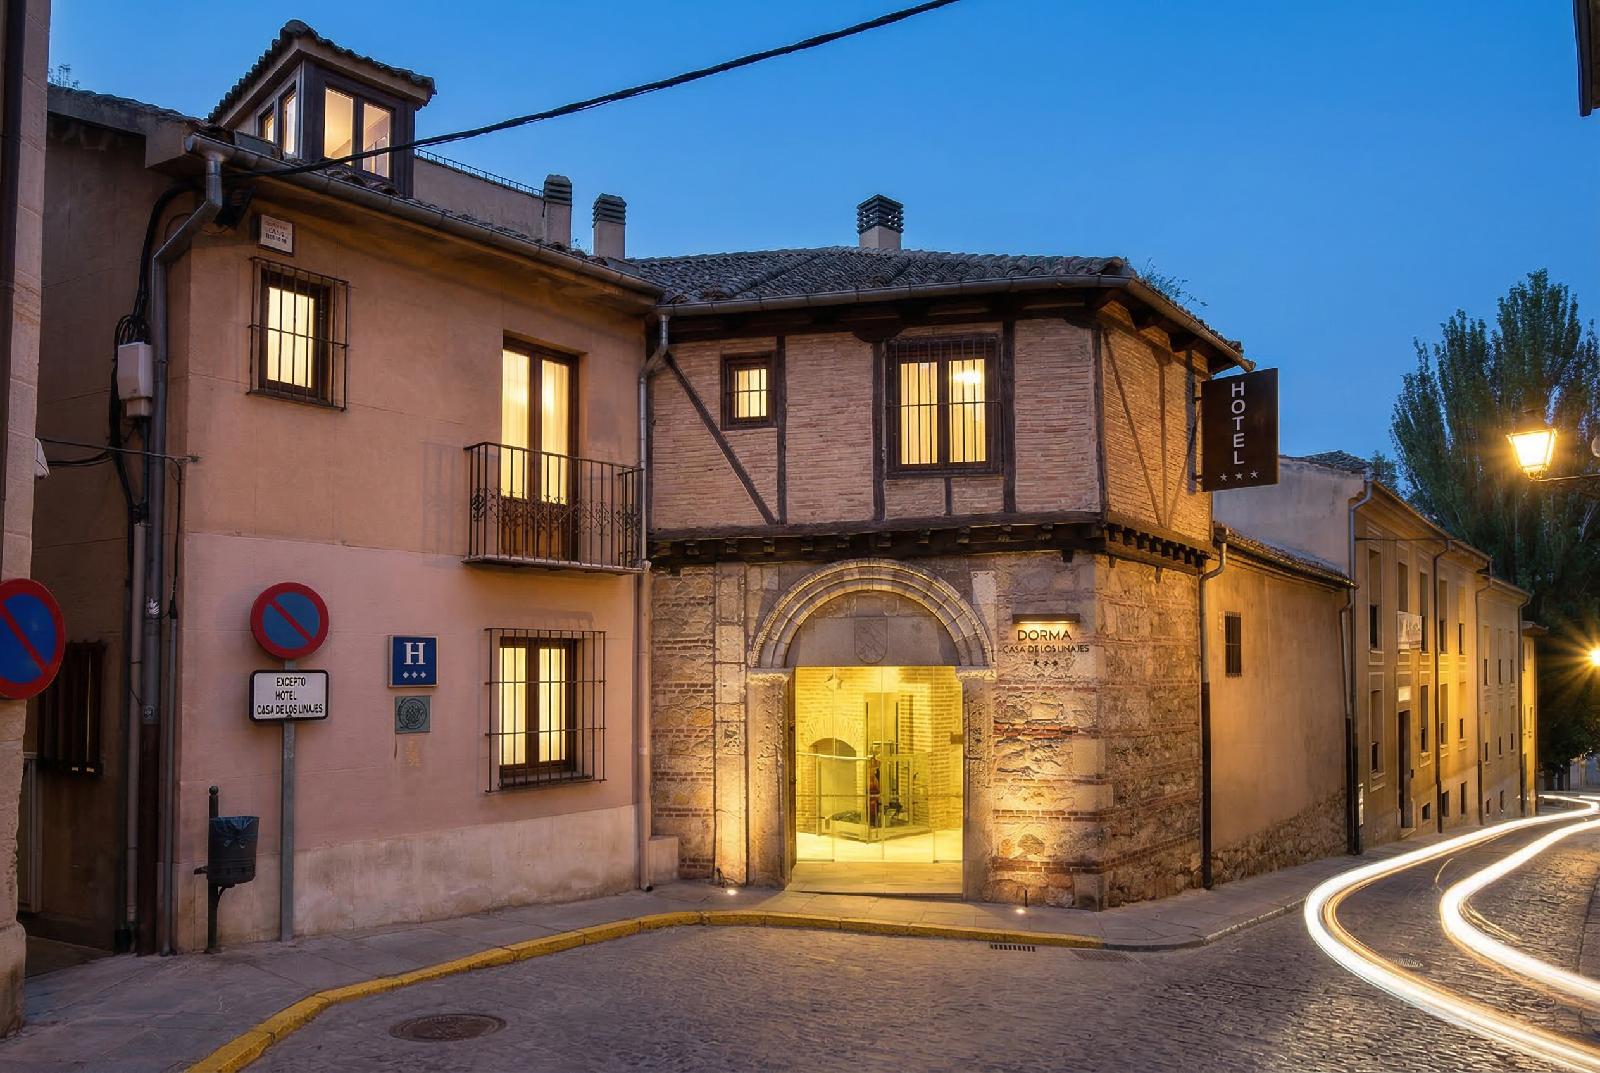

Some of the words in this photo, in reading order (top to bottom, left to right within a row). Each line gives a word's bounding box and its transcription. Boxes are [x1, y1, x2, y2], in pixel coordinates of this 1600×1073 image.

[1231, 381, 1246, 465] HOTEL
[1017, 629, 1073, 641] DORMA
[403, 642, 426, 665] H
[1002, 645, 1026, 654] CASA
[1027, 645, 1039, 653] DE
[1040, 645, 1056, 653] LOS
[1057, 644, 1090, 653] LINAJES
[276, 677, 306, 687] EXCEPTO
[275, 690, 297, 701] HOTEL
[256, 704, 274, 715] CASA
[275, 704, 285, 715] DE
[285, 704, 298, 714] LOS
[298, 703, 323, 714] LINAJES
